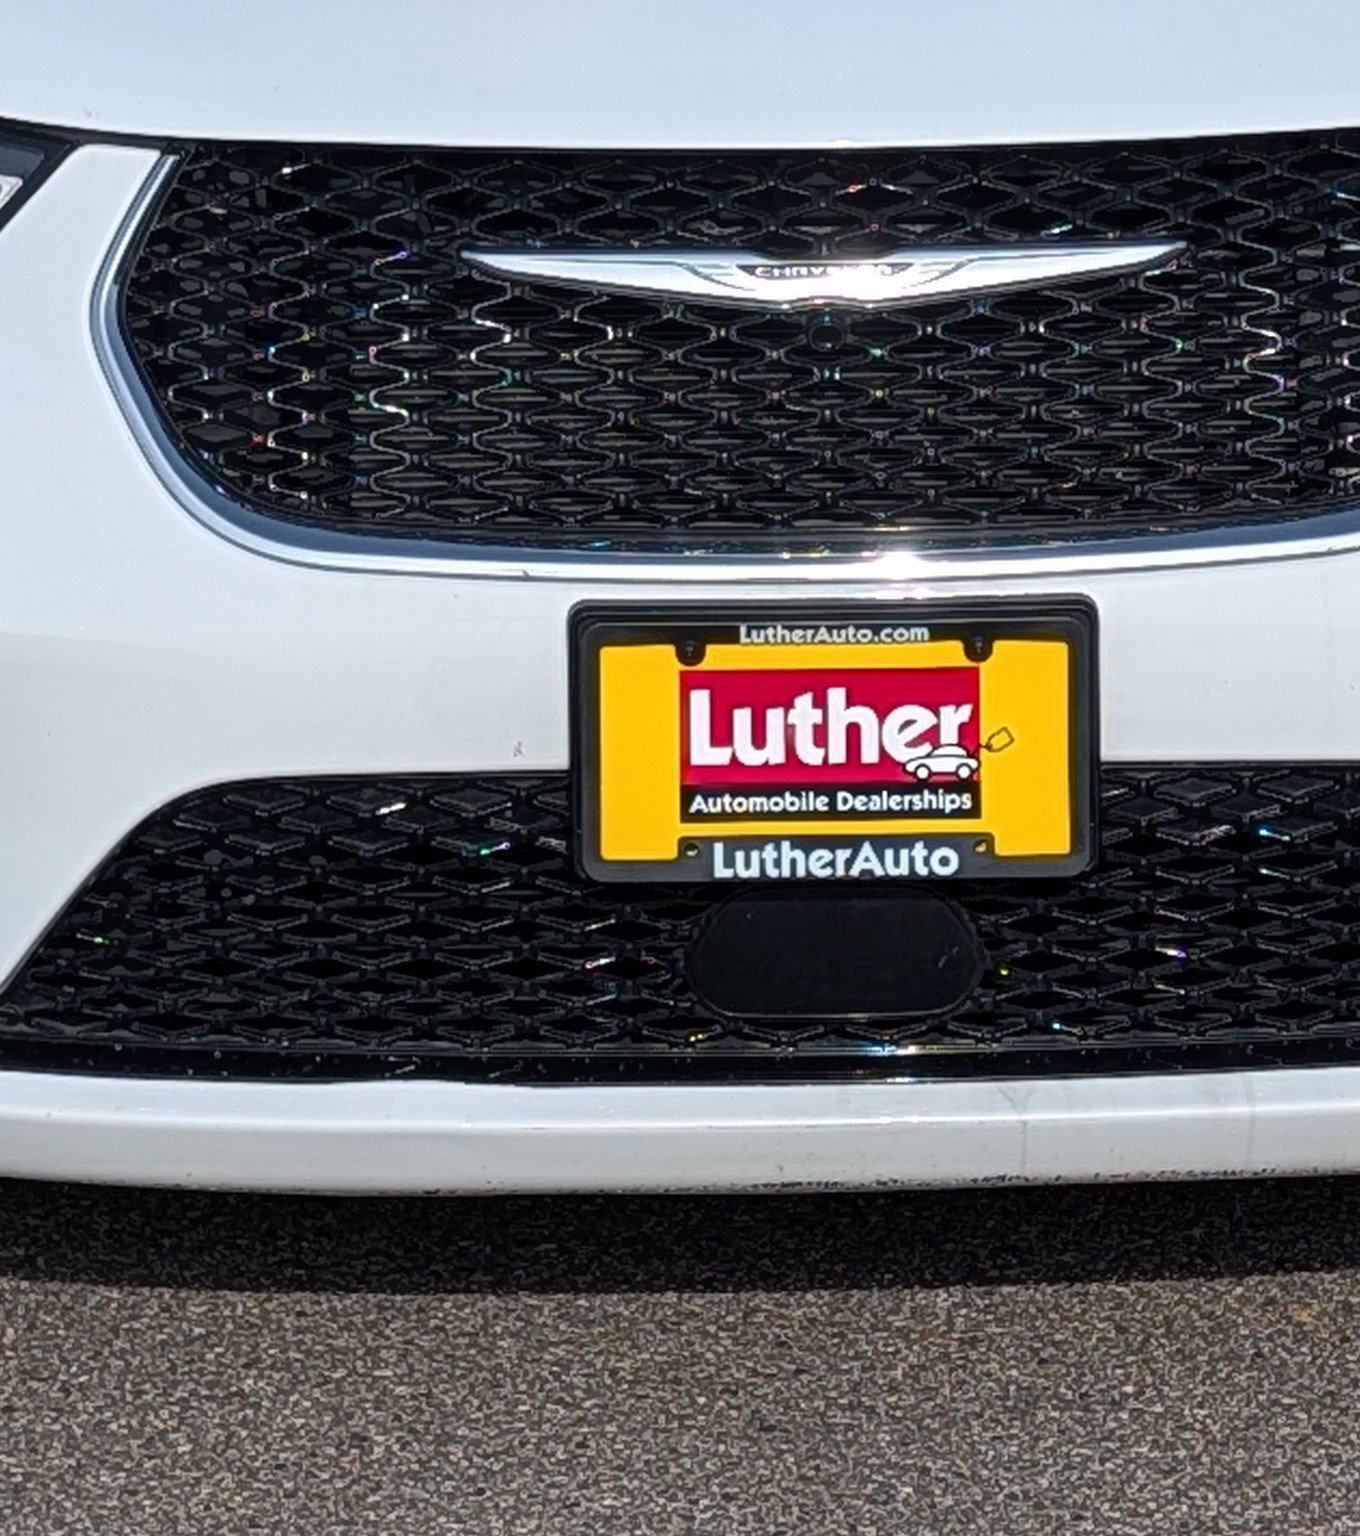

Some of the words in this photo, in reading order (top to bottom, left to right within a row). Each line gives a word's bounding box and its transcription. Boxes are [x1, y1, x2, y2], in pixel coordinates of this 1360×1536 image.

[739, 624, 930, 644] LutherAuto.com
[688, 686, 974, 767] Luther
[688, 790, 830, 815] Automobile
[836, 788, 973, 814] Dealerships
[712, 839, 959, 879] LutherAuto
